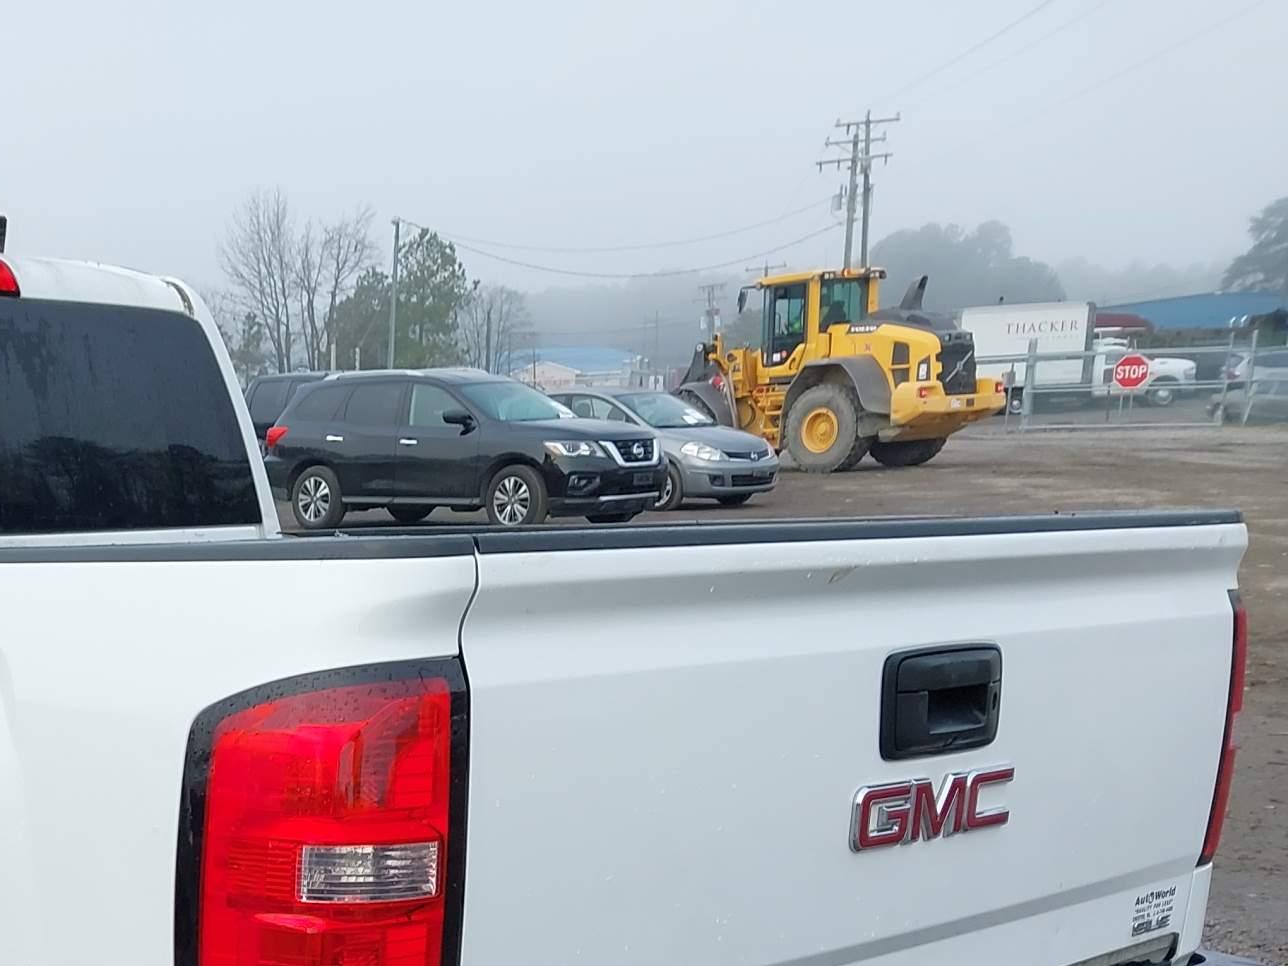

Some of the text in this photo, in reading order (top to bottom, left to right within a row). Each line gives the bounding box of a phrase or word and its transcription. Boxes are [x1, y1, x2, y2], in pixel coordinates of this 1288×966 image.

[1007, 319, 1079, 335] THACKER
[1116, 364, 1147, 380] STOP
[848, 763, 1015, 853] GMC
